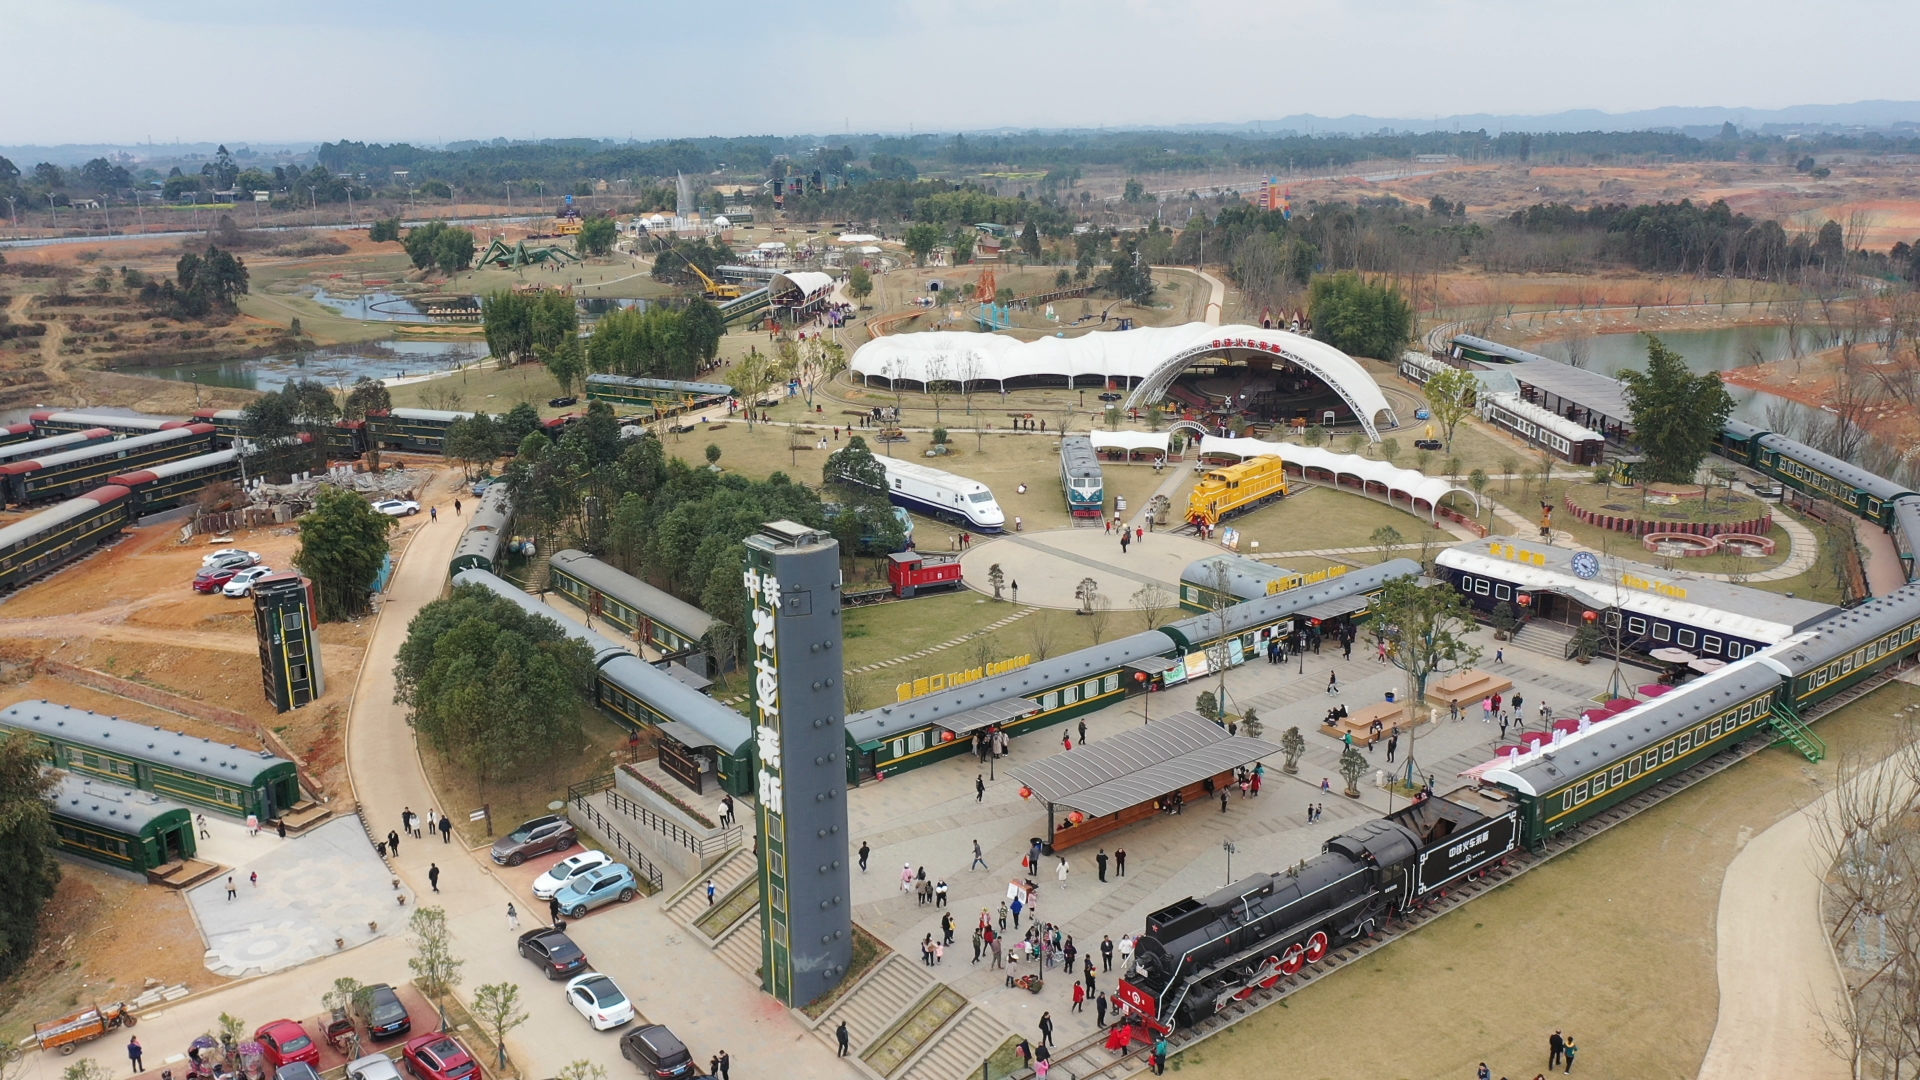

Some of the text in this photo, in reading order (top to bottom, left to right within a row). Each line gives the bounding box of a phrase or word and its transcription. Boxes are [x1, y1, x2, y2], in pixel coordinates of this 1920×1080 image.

[743, 567, 782, 609] 中铁
[1302, 569, 1327, 586] Ticket
[1654, 581, 1687, 599] Train
[896, 654, 1031, 702] 售票口 Ticket Counter
